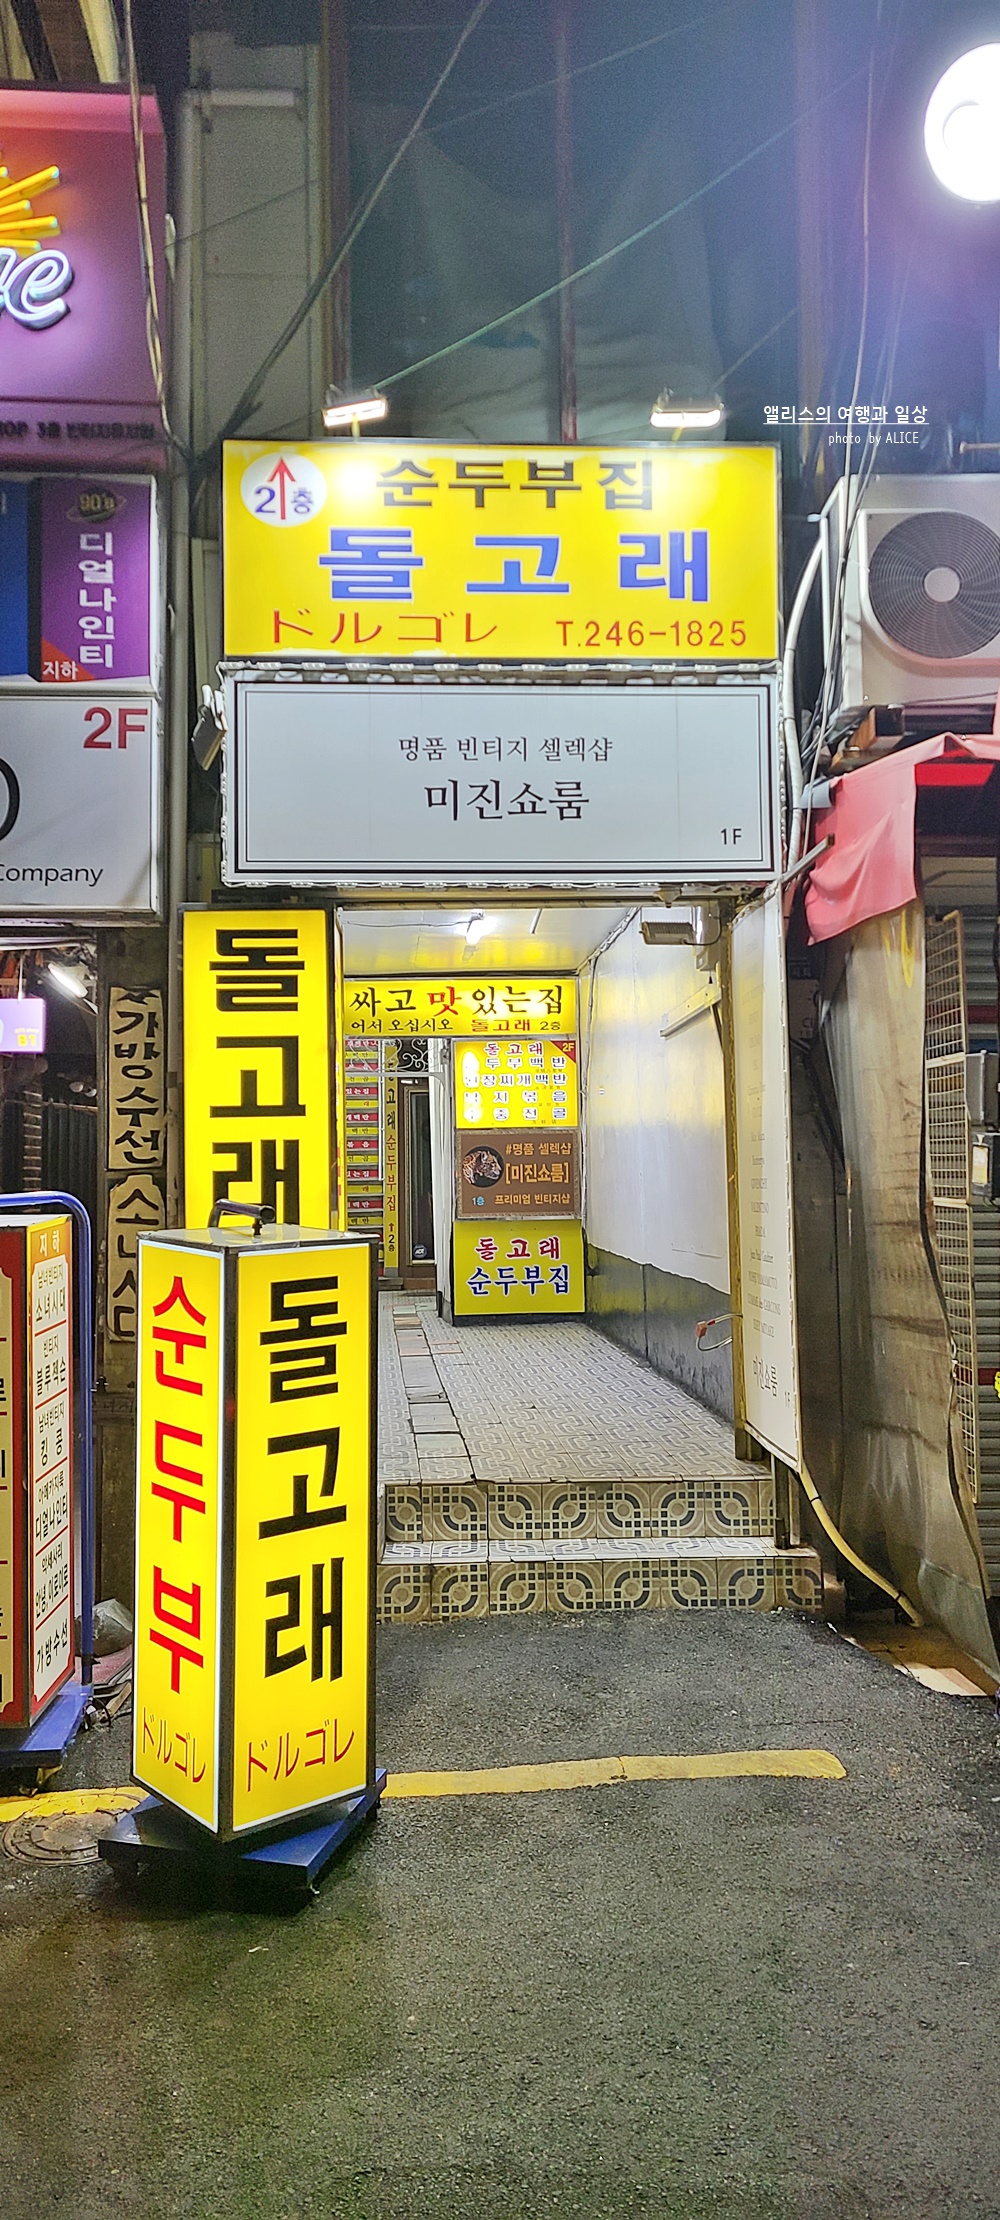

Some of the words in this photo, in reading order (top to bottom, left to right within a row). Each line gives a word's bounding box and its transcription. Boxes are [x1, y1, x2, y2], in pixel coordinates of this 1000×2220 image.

[376, 457, 654, 511] 순두부집
[254, 485, 315, 516] 2층
[318, 526, 710, 603] 돌고래
[77, 531, 118, 669] 디얼나인티
[272, 608, 498, 644] ドルゴレ
[556, 620, 748, 648] T.246-1825
[43, 659, 79, 680] 지하
[83, 706, 149, 751] 2F
[398, 736, 448, 763] 명품
[457, 736, 529, 763] 빈티지
[538, 736, 613, 763] 셀렉샵
[424, 779, 590, 821] 미진쇼룸
[720, 828, 742, 846] 1F
[349, 986, 417, 1017] 싸고
[18, 1034, 37, 1047] B1
[351, 1018, 383, 1033] 어서
[388, 1018, 454, 1033] 오십시오
[470, 1018, 531, 1033] 돌고래
[540, 1020, 561, 1032] 2층
[485, 1042, 543, 1056] 돌고래
[562, 1042, 575, 1053] 2F
[113, 1011, 161, 1164] 가방수선
[209, 929, 307, 1226] 돌고래
[505, 1143, 535, 1156] #명품
[538, 1143, 572, 1156] 셀렉샵
[386, 1134, 397, 1212] 순두부집
[505, 1162, 570, 1185] [미진쇼룸]
[472, 1195, 485, 1207] 1층
[494, 1194, 531, 1206] 프리미엄
[534, 1193, 571, 1206] 빈티지샵
[39, 1229, 60, 1257] 지하
[388, 1234, 396, 1252] 2층
[475, 1235, 561, 1260] 돌고래
[466, 1266, 570, 1298] 순두부집
[35, 1287, 66, 1322] 소녀시대
[43, 1334, 59, 1358] 빈티지
[149, 1275, 207, 1694] 순두부
[258, 1275, 348, 1683] 돌고래
[35, 1491, 68, 1542] 디얼나인티
[41, 1541, 63, 1575] 악세사리
[36, 1617, 68, 1674] 가방수선
